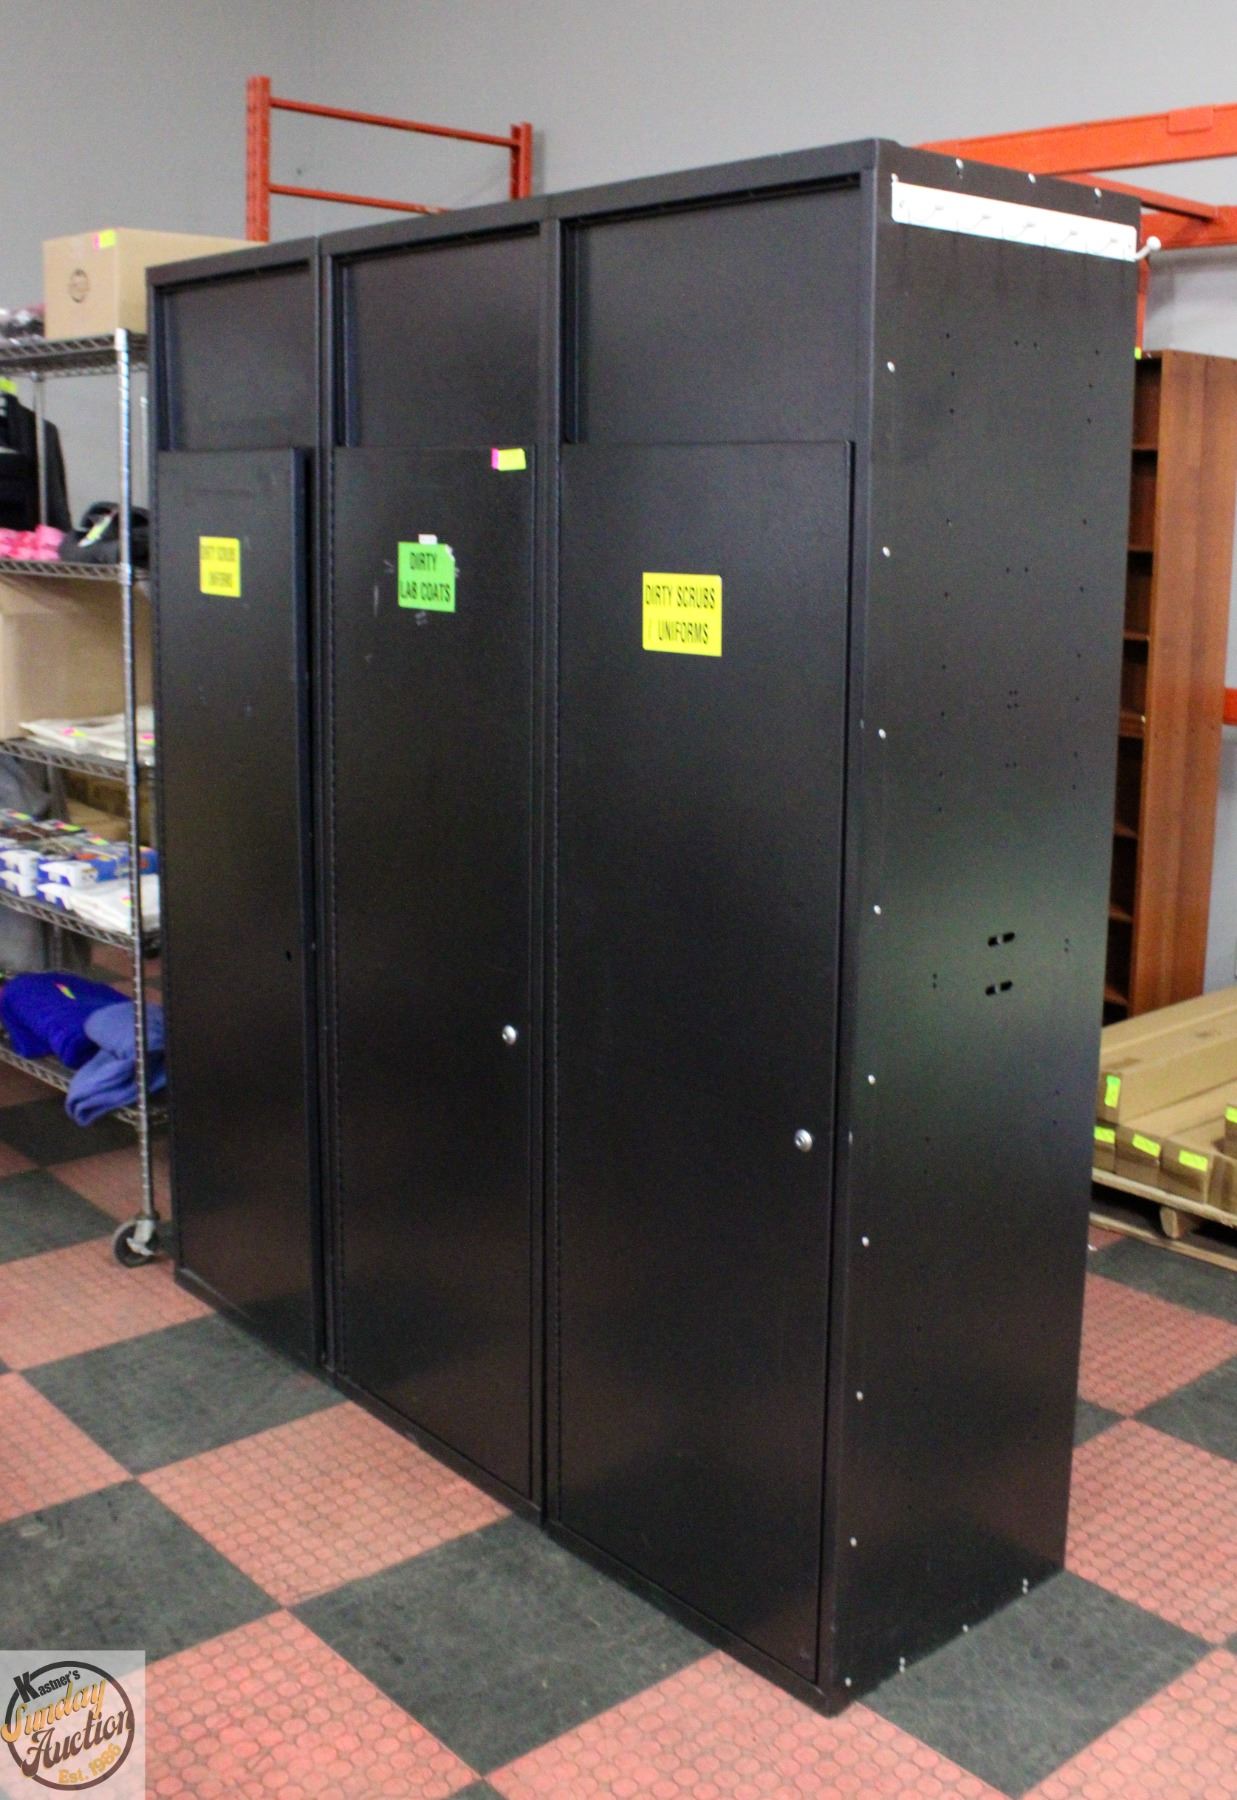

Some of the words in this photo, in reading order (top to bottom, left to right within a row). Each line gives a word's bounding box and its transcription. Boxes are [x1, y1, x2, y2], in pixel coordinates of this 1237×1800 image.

[409, 552, 438, 571] DIRTY
[400, 580, 417, 600] LAB
[420, 582, 451, 603] COATS
[645, 584, 672, 606] DIRTY
[677, 585, 715, 610] SCRUBS
[658, 620, 708, 645] UNIFORMS
